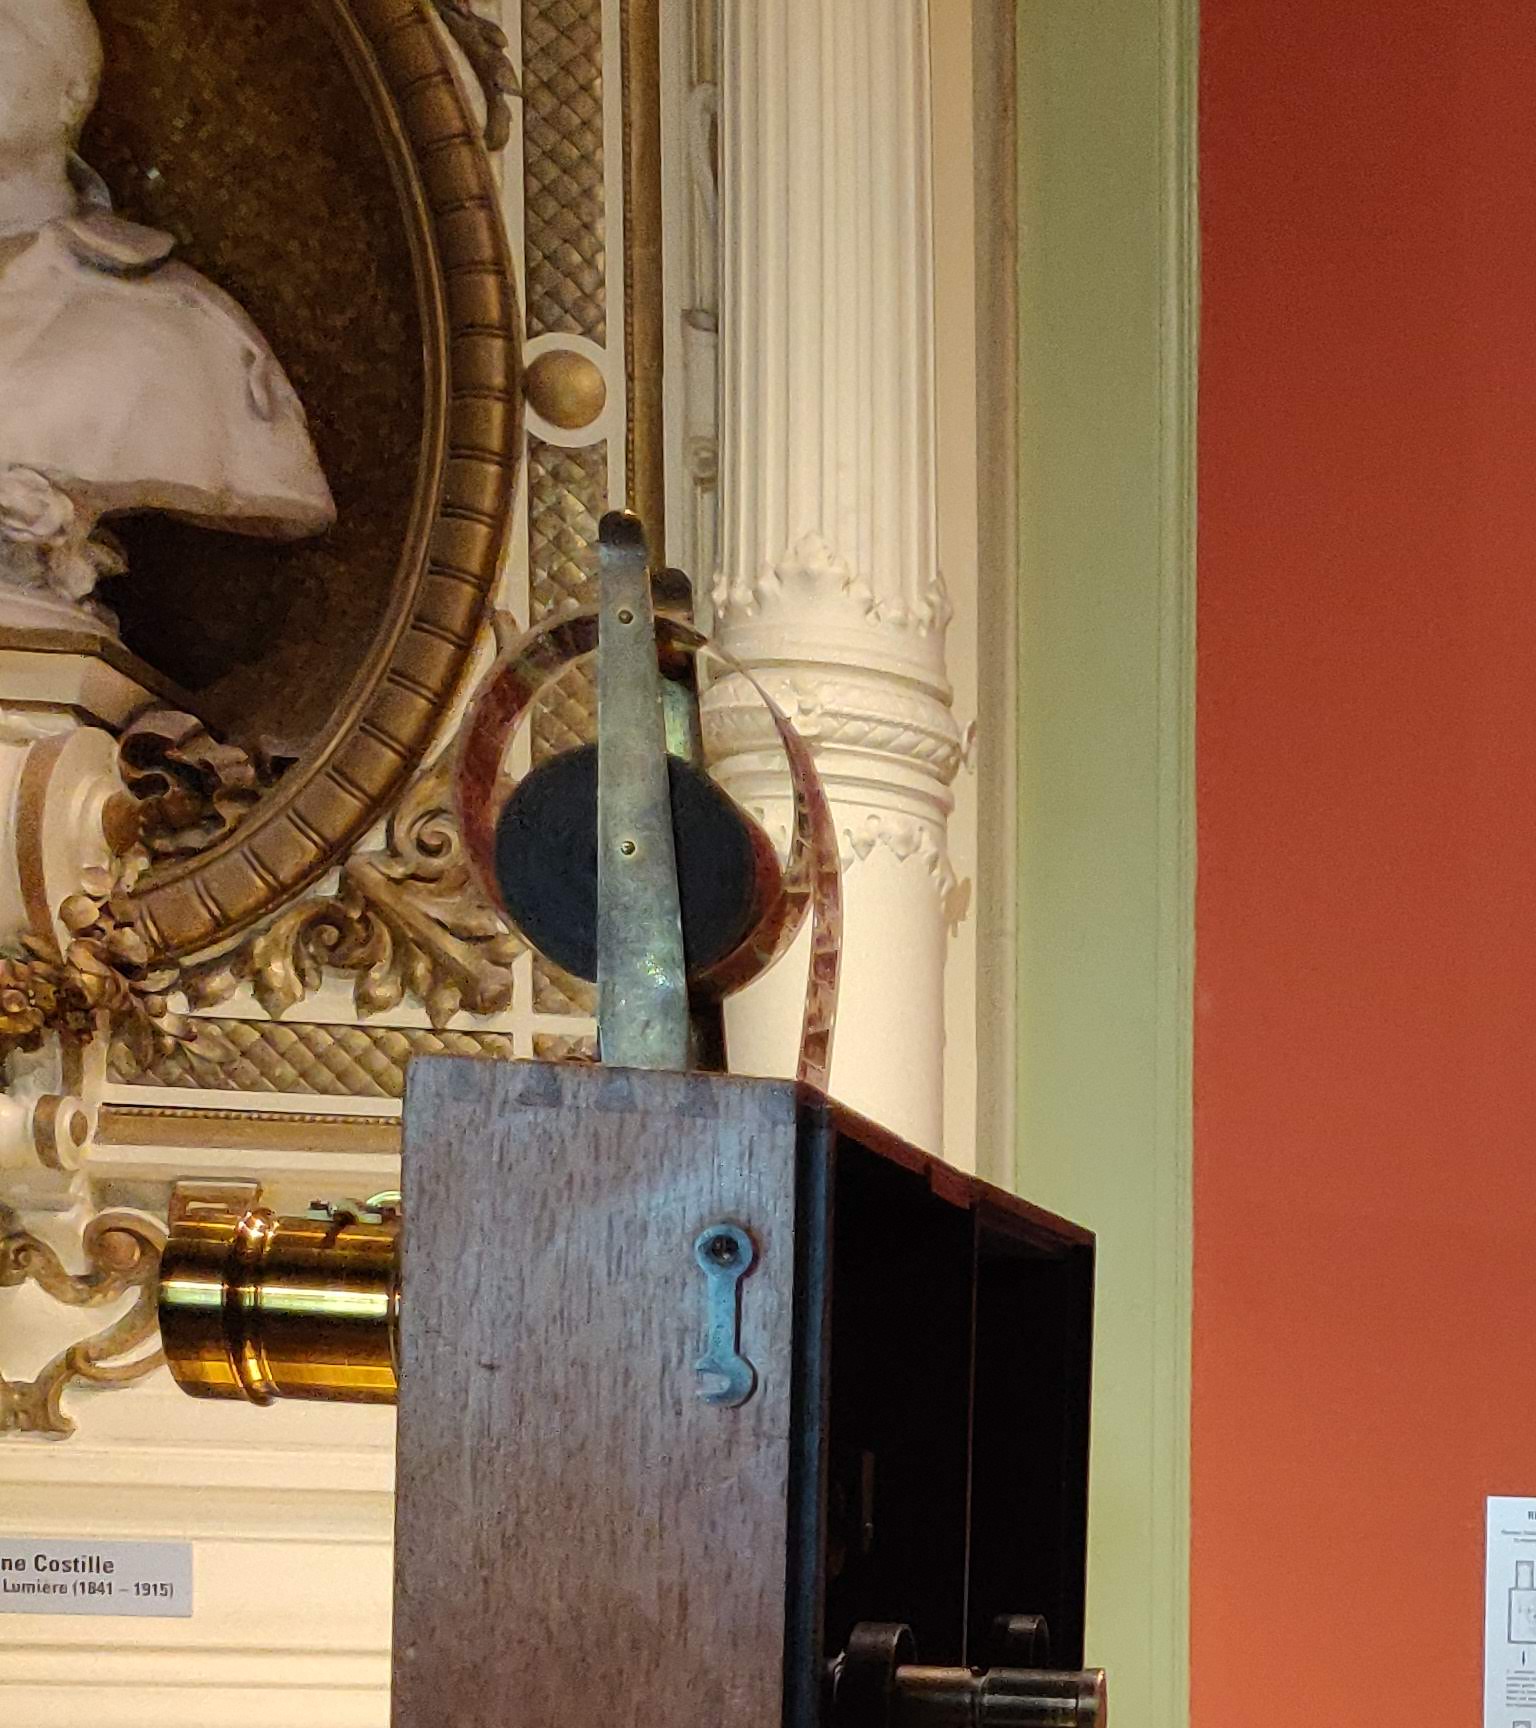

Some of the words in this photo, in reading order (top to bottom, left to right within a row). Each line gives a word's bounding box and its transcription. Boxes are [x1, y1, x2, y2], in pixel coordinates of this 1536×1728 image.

[34, 1554, 114, 1574] Costille
[72, 1581, 112, 1597] (1841
[134, 1581, 174, 1599] 1915)
